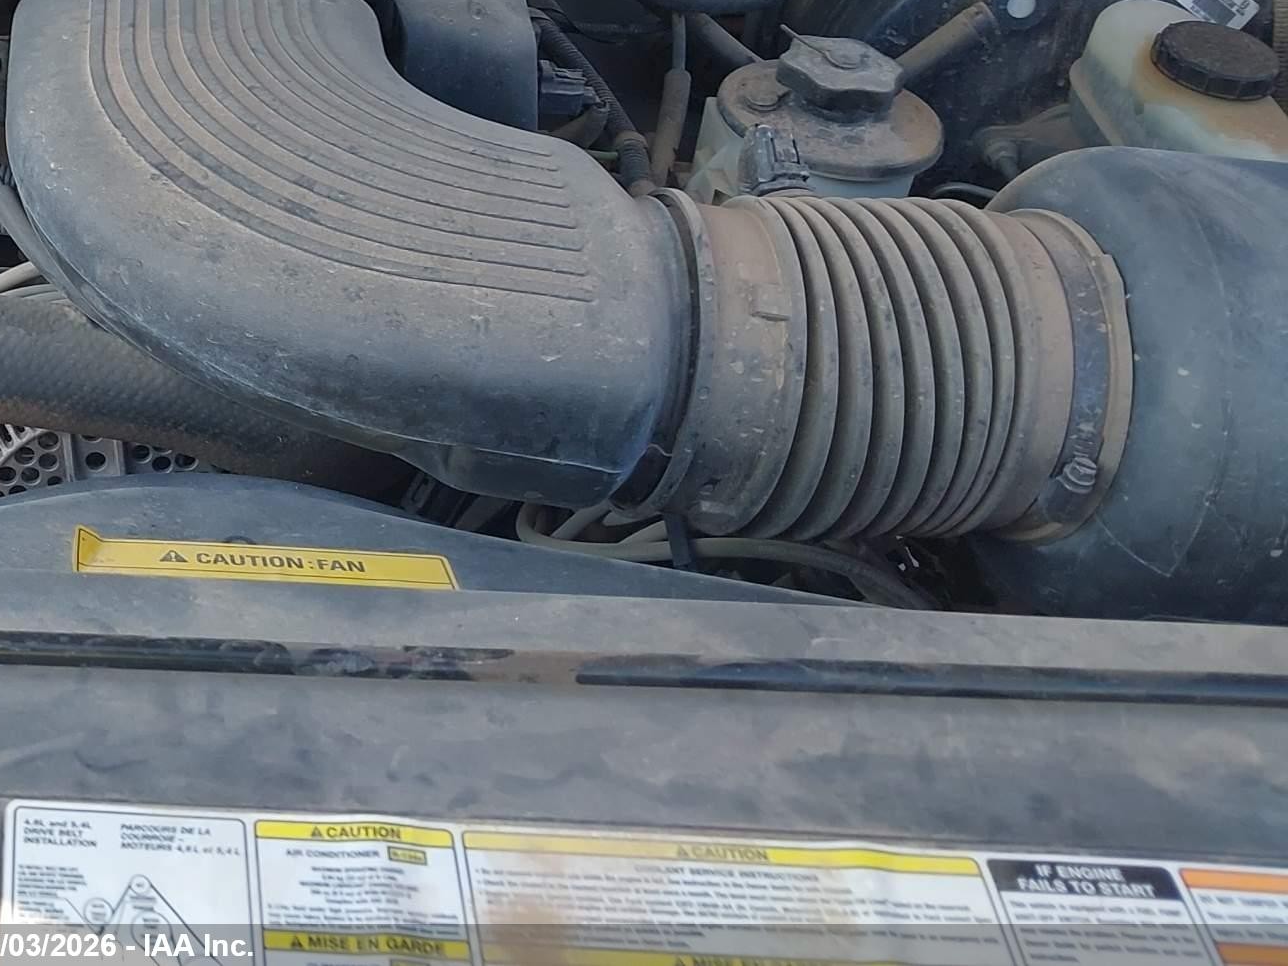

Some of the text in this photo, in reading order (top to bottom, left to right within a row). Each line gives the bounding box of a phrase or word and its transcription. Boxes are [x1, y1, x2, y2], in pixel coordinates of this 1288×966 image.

[58, 829, 84, 838] BELT
[198, 828, 212, 837] LA
[325, 826, 402, 840] CAUTION
[23, 836, 98, 848] INSTALLATION
[285, 848, 309, 857] AIR
[311, 849, 381, 859] CONDITIONER
[691, 847, 769, 861] CAUTION
[1034, 864, 1127, 883] IF ENGINE
[1016, 877, 1157, 898] FAILS TO START
[311, 936, 347, 950] MISE
[386, 938, 447, 954] GARDE
